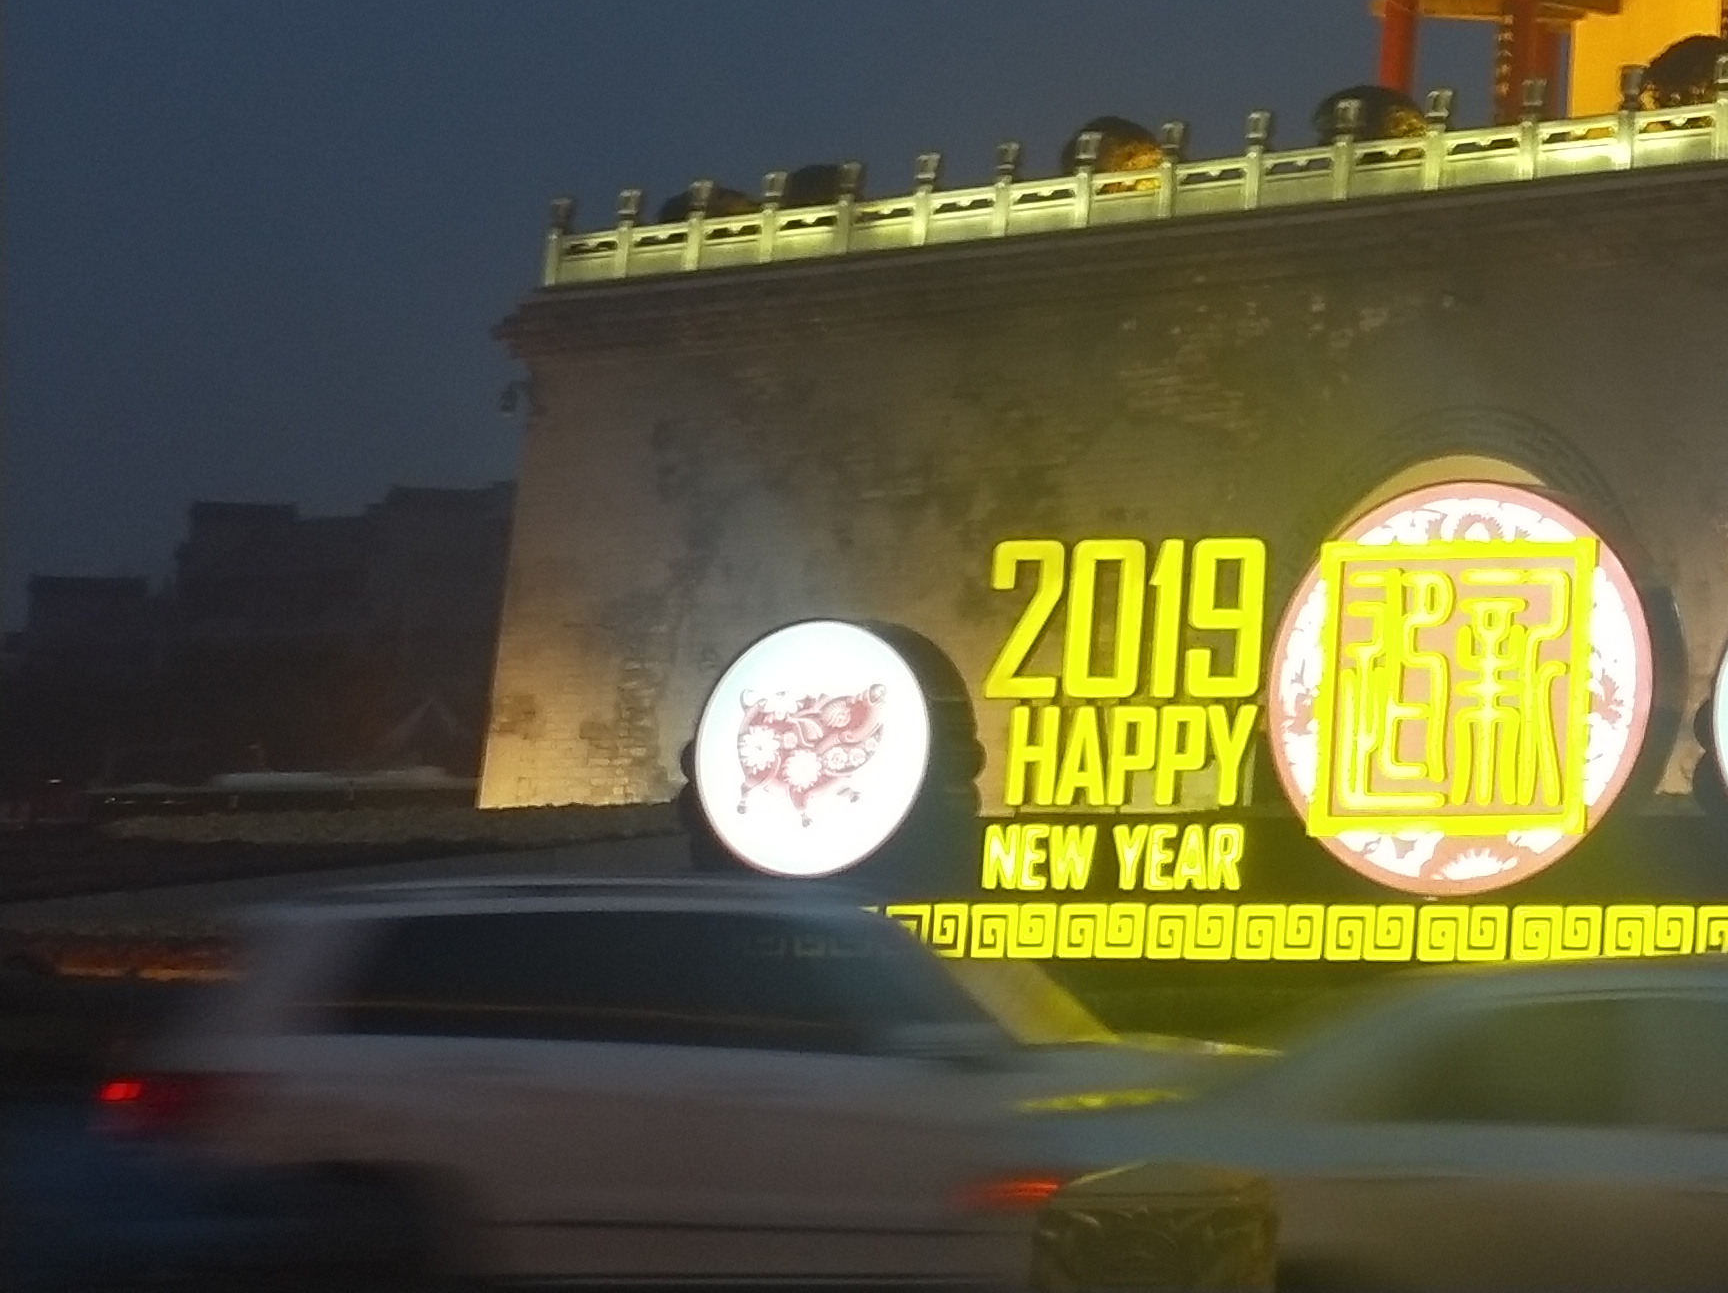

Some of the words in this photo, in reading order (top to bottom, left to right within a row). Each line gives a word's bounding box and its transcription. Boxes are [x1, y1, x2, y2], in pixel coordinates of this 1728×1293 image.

[985, 539, 1266, 699] 2019
[1006, 704, 1258, 806] HAPPY
[982, 825, 1097, 890] NEW
[1114, 824, 1243, 890] YEAR
